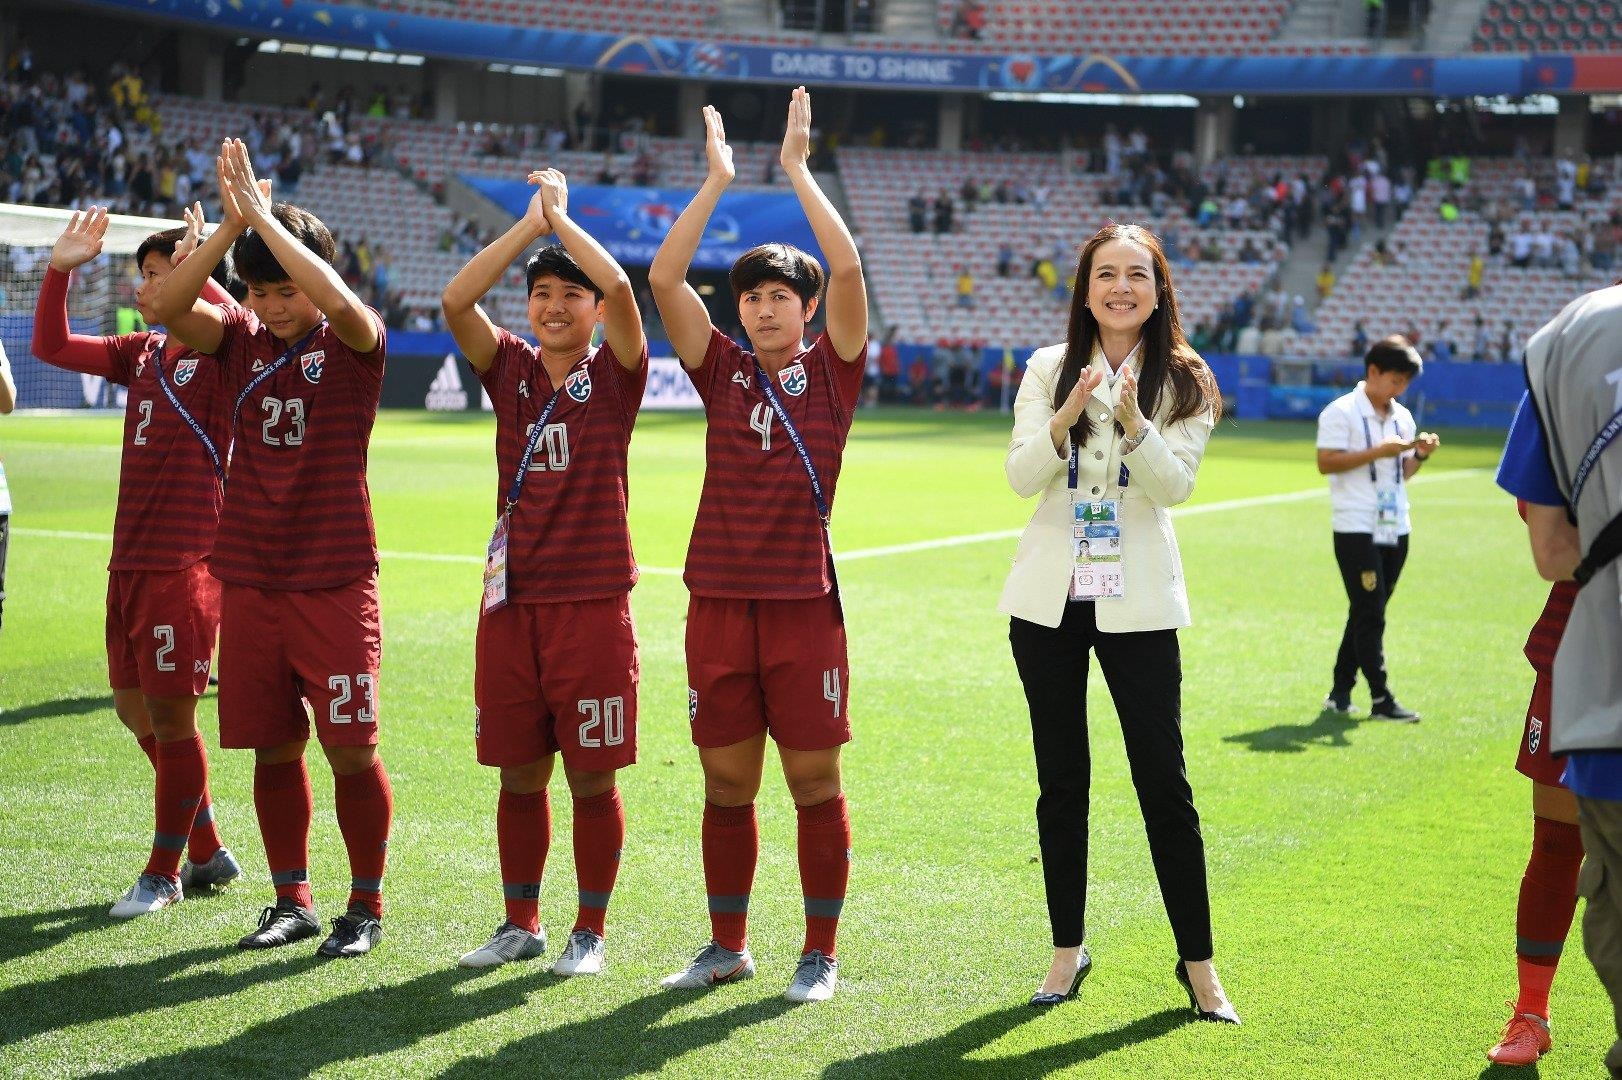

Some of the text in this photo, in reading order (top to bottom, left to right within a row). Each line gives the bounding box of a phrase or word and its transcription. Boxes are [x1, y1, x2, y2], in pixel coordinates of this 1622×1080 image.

[771, 52, 836, 78] DARE
[841, 55, 876, 79] TO
[244, 381, 255, 394] CUP
[255, 365, 276, 386] FRANCE
[273, 356, 287, 369] 2019
[134, 400, 153, 445] 2
[164, 386, 179, 408] WOMEN'S
[178, 405, 194, 425] WORLD
[192, 423, 204, 436] CUP
[262, 396, 305, 446] 23
[534, 409, 549, 431] WORLD
[750, 402, 774, 451] 4
[520, 444, 533, 469] FRANCE
[526, 422, 569, 472] 20
[530, 429, 540, 445] CUP
[764, 387, 821, 494] FIFA WOMEN'S WORLD CUP FRANCE 2019
[515, 469, 525, 482] 2019
[154, 625, 175, 671] 2
[328, 674, 374, 723] 23
[823, 667, 840, 718] 4
[578, 696, 624, 747] 20
